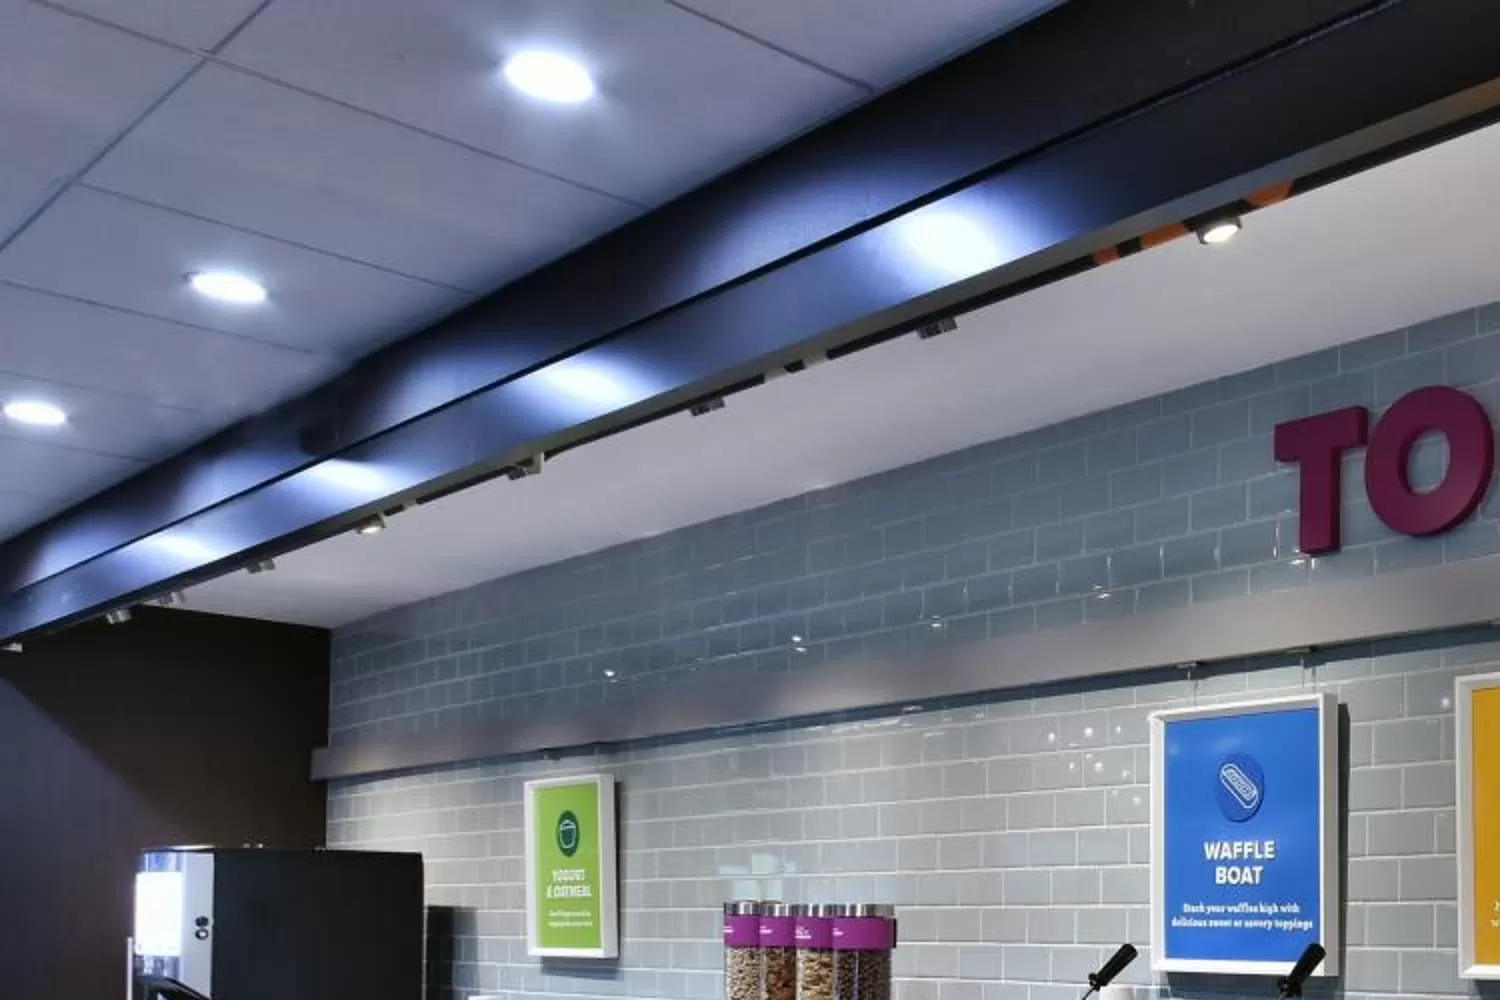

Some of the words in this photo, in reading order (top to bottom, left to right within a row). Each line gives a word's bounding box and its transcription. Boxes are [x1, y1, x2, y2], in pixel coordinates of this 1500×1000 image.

[1203, 840, 1275, 860] WAFFLE
[1215, 865, 1264, 885] BOAT
[1205, 905, 1226, 915] your
[1227, 902, 1258, 913] waffles
[1259, 902, 1278, 916] high
[1280, 902, 1300, 913] with
[1275, 917, 1313, 931] toppings
